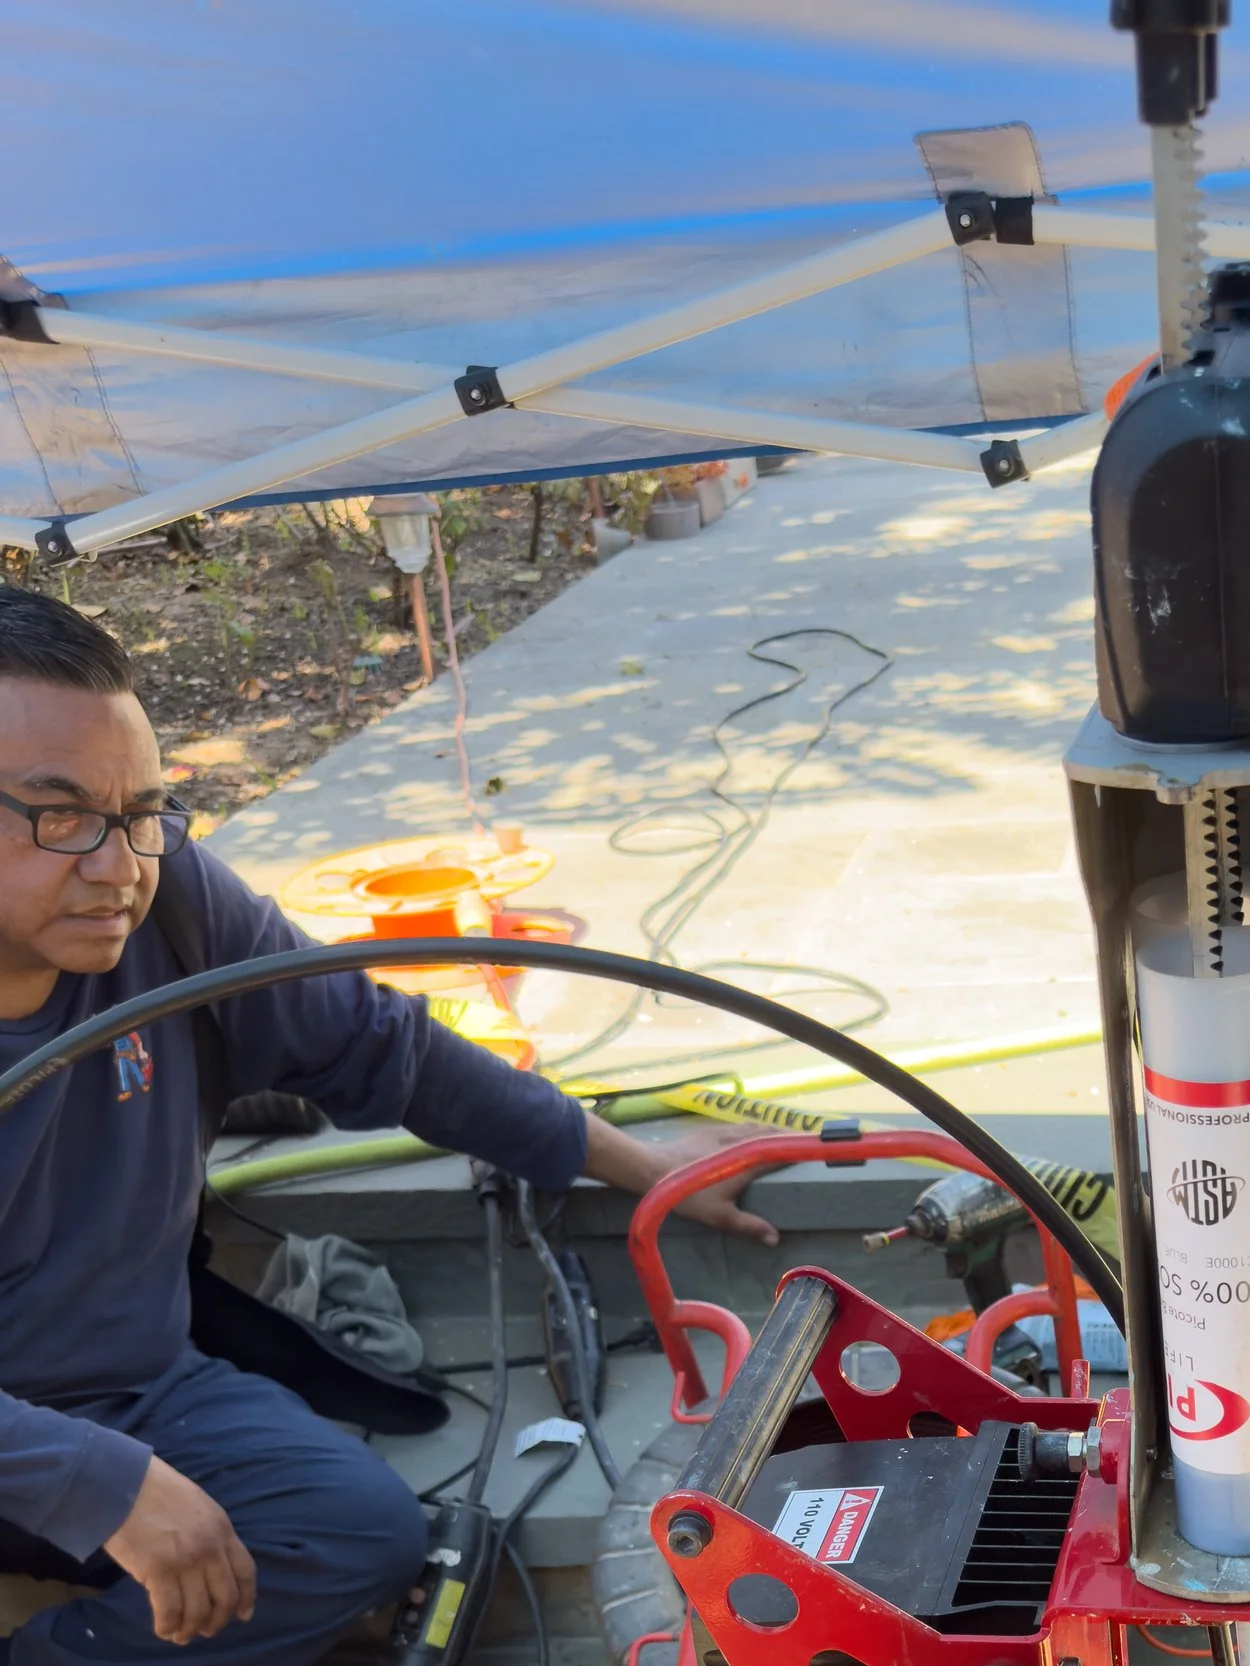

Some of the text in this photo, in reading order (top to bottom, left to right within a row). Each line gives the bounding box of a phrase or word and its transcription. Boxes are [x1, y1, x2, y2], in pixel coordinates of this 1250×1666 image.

[1156, 1102, 1250, 1126] PROFESSIONAL
[1170, 1158, 1239, 1226] ASTM
[1169, 1305, 1206, 1330] Picote
[804, 1497, 825, 1517] 110
[826, 1511, 859, 1559] DANGER
